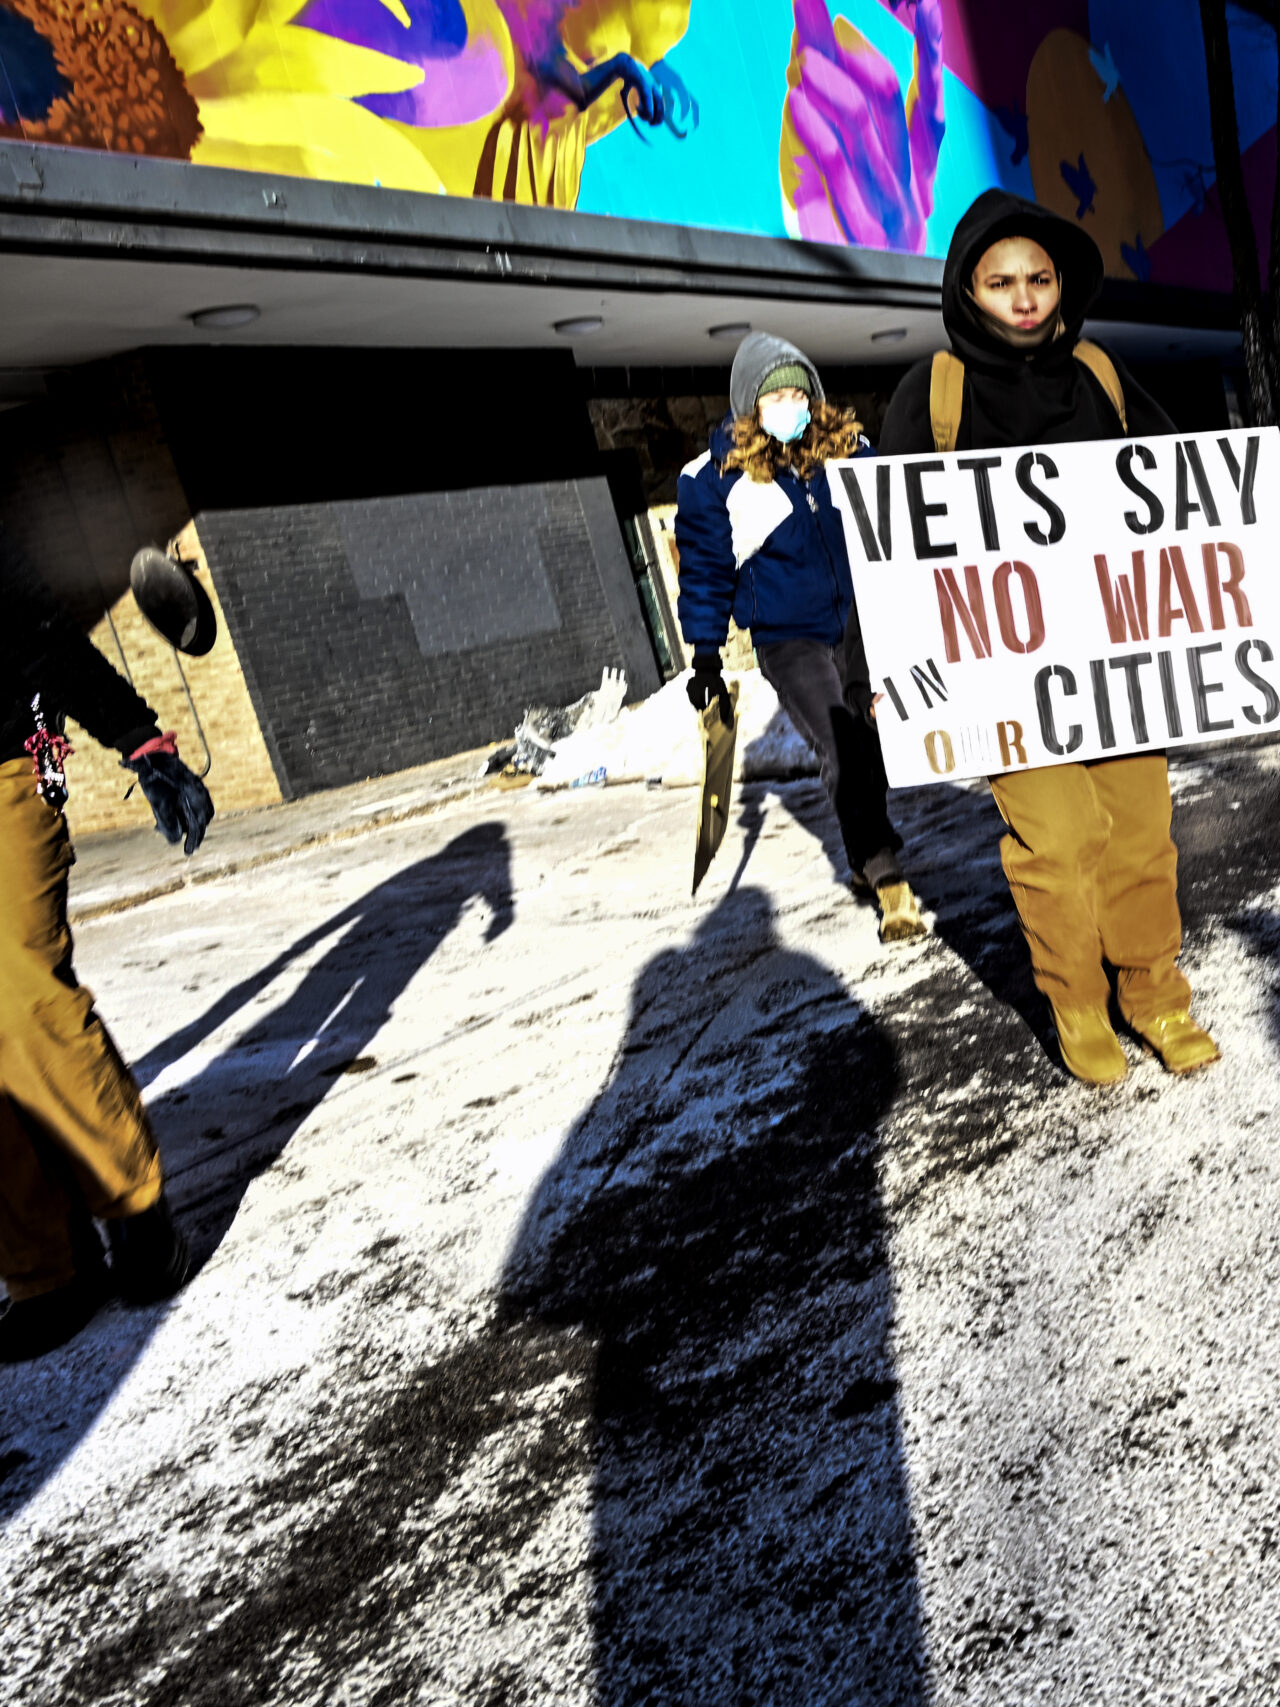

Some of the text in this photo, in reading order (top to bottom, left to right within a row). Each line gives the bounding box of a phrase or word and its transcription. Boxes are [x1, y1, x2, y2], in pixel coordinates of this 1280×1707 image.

[838, 436, 1260, 562] VETS SAY
[933, 542, 1253, 663] NO WAR
[882, 658, 948, 721] IN
[923, 639, 1280, 774] OUR CITIES
